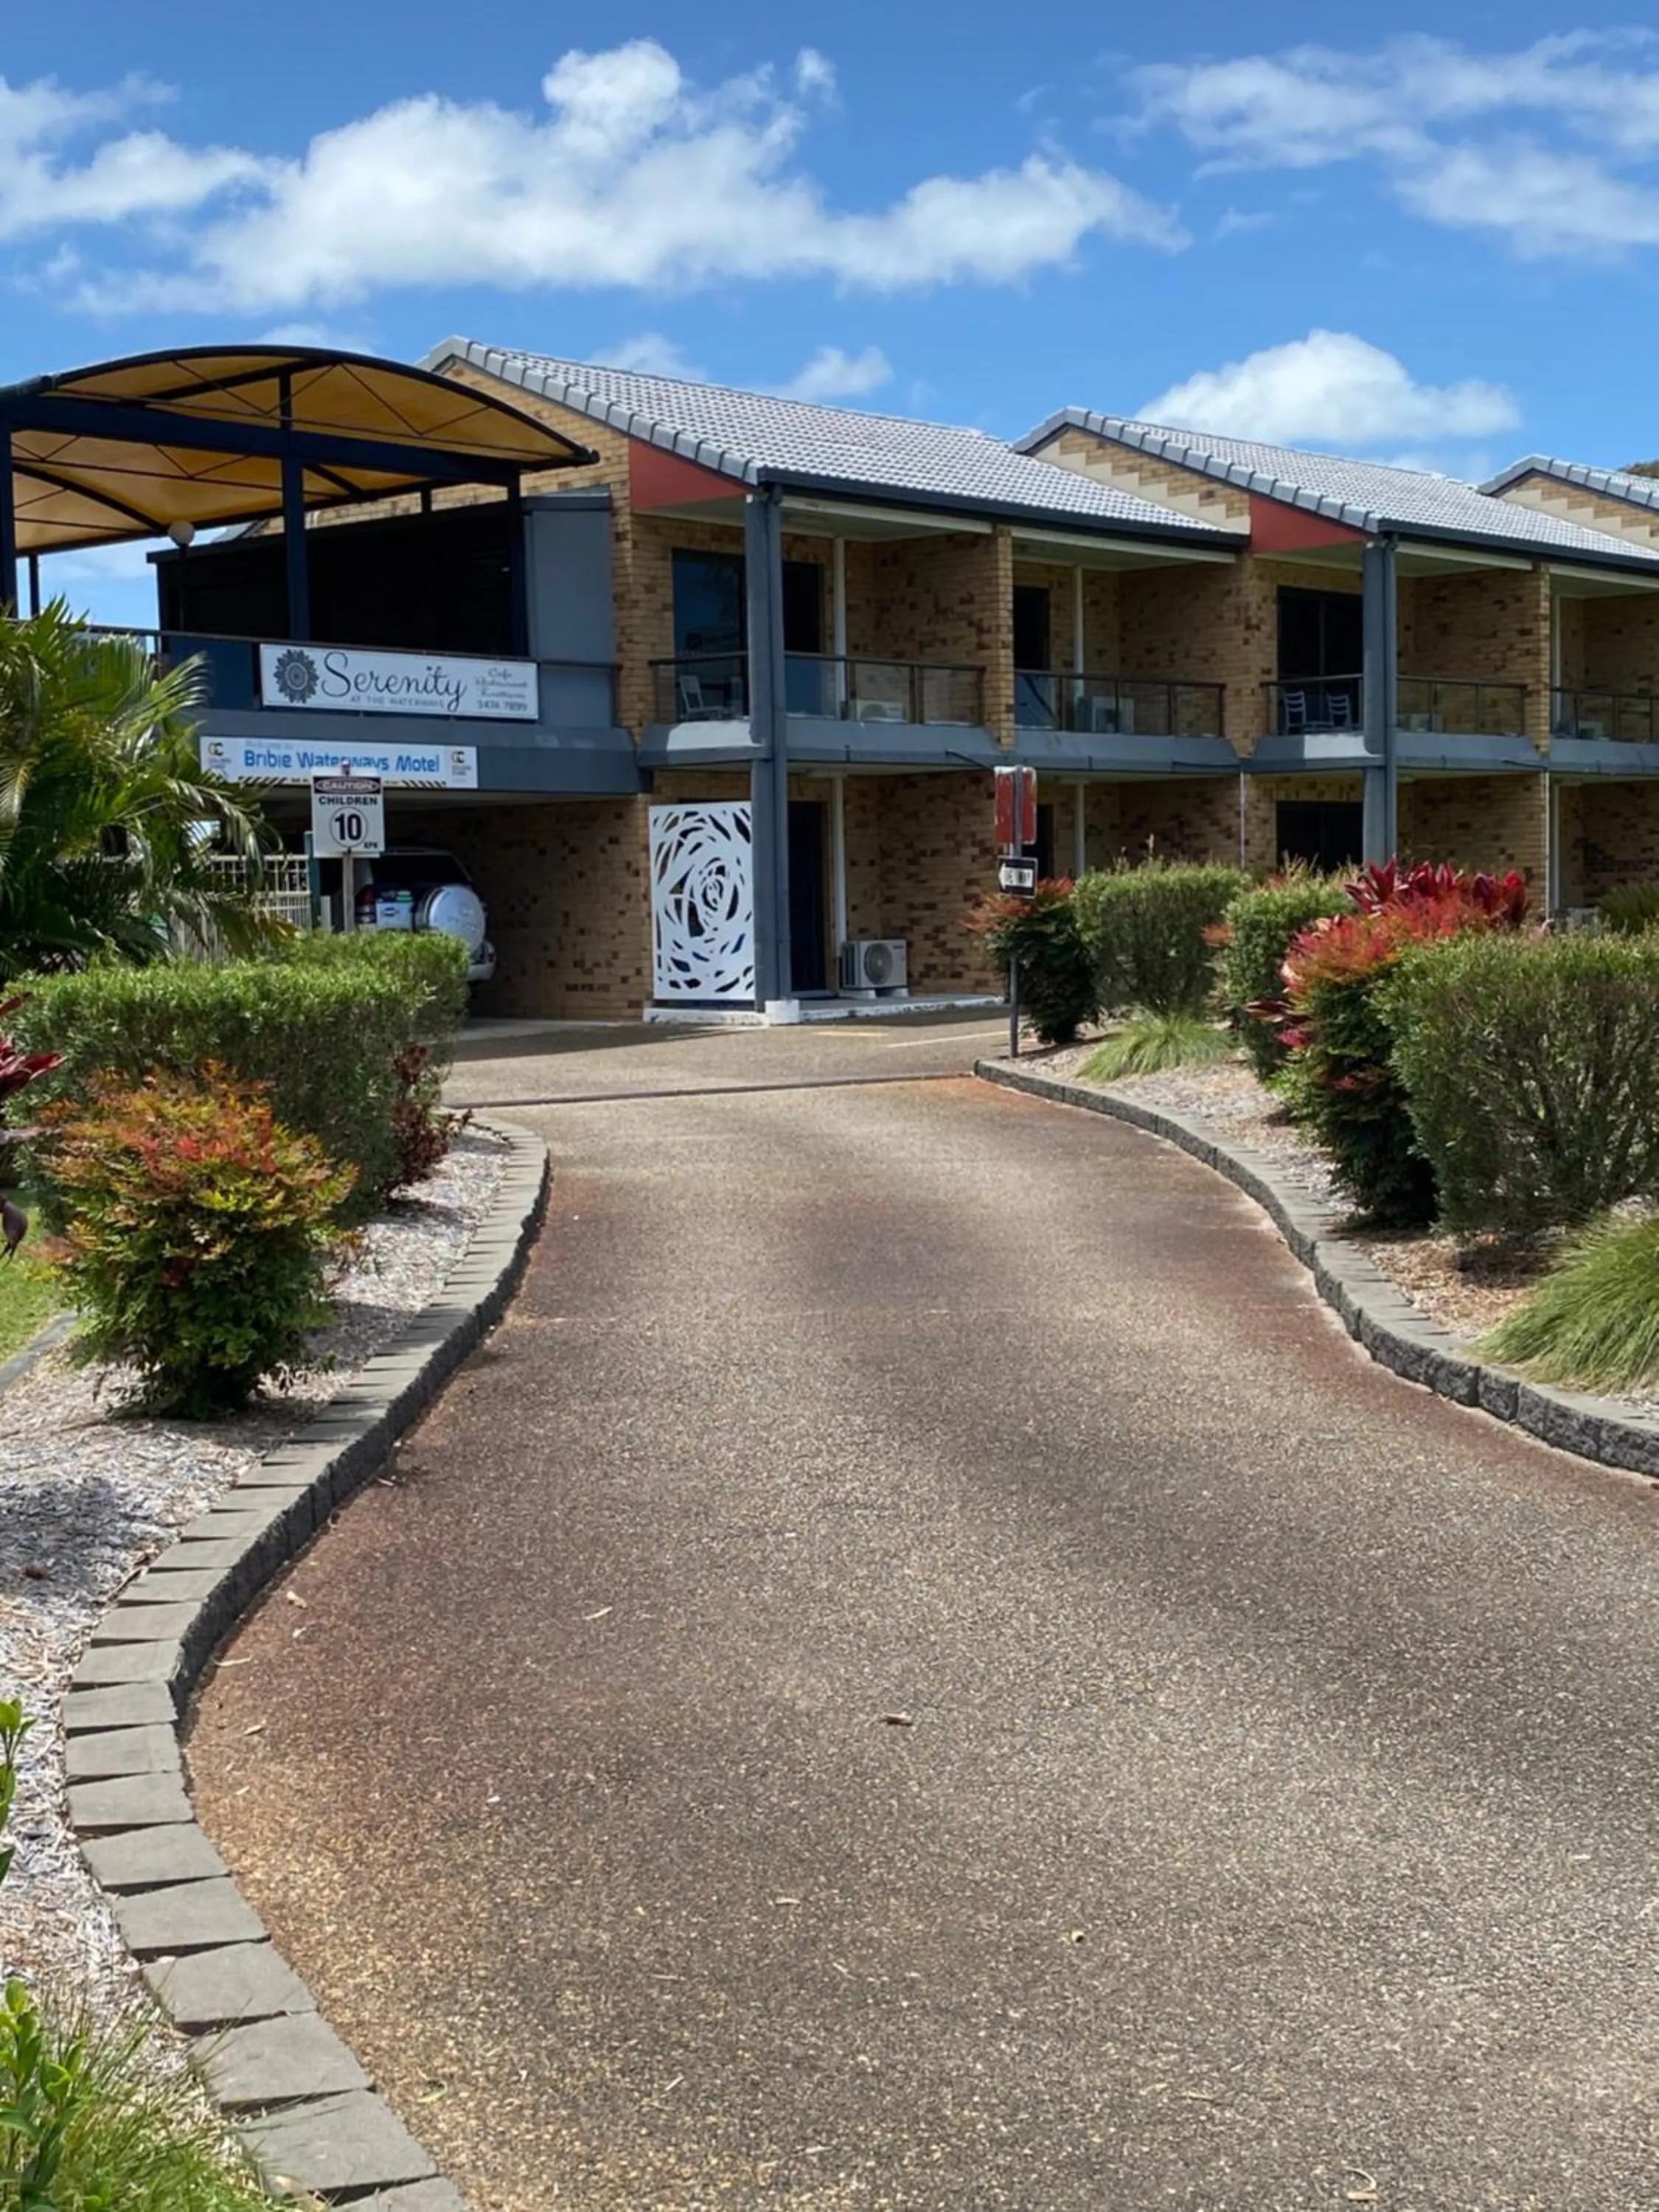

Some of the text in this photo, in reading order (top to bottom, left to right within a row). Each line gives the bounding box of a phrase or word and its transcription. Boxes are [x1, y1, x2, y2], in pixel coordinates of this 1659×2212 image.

[321, 651, 467, 712] Serenity
[243, 749, 292, 768] Bribie
[296, 751, 389, 771] Wateways
[396, 754, 440, 773] Motel
[320, 780, 374, 791] CAUTION
[319, 796, 378, 805] CHILDREN
[335, 813, 362, 841] 10
